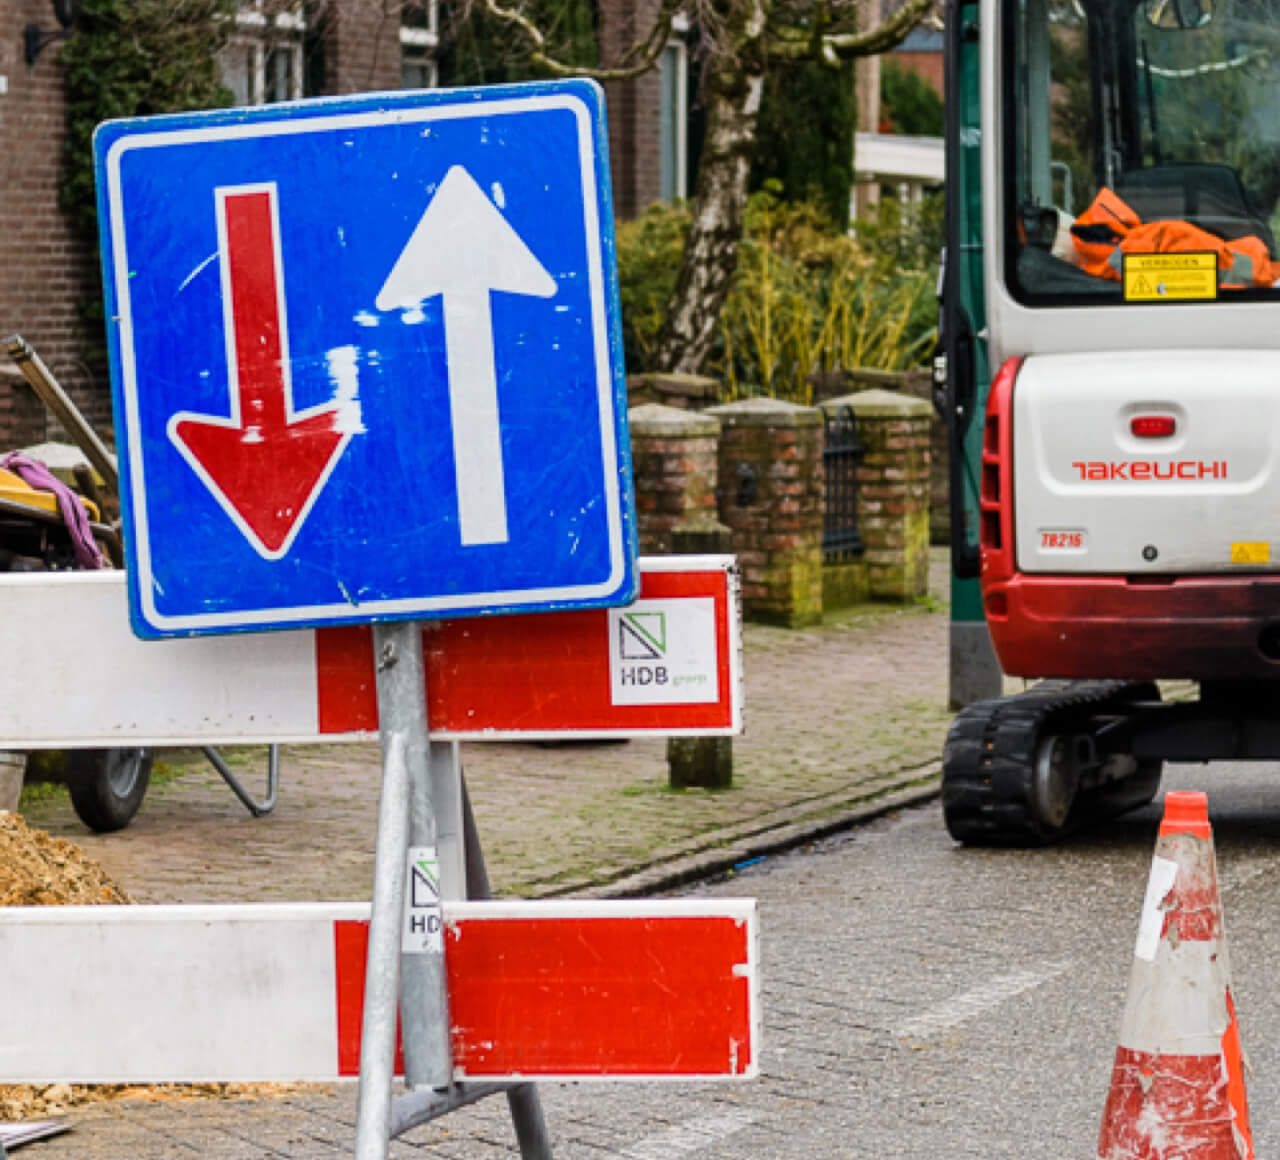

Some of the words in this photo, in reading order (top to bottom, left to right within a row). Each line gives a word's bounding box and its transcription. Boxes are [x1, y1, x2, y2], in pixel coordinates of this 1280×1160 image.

[1072, 461, 1228, 481] TAKEUCHI
[1041, 533, 1083, 548] TB216
[621, 666, 669, 686] HDB
